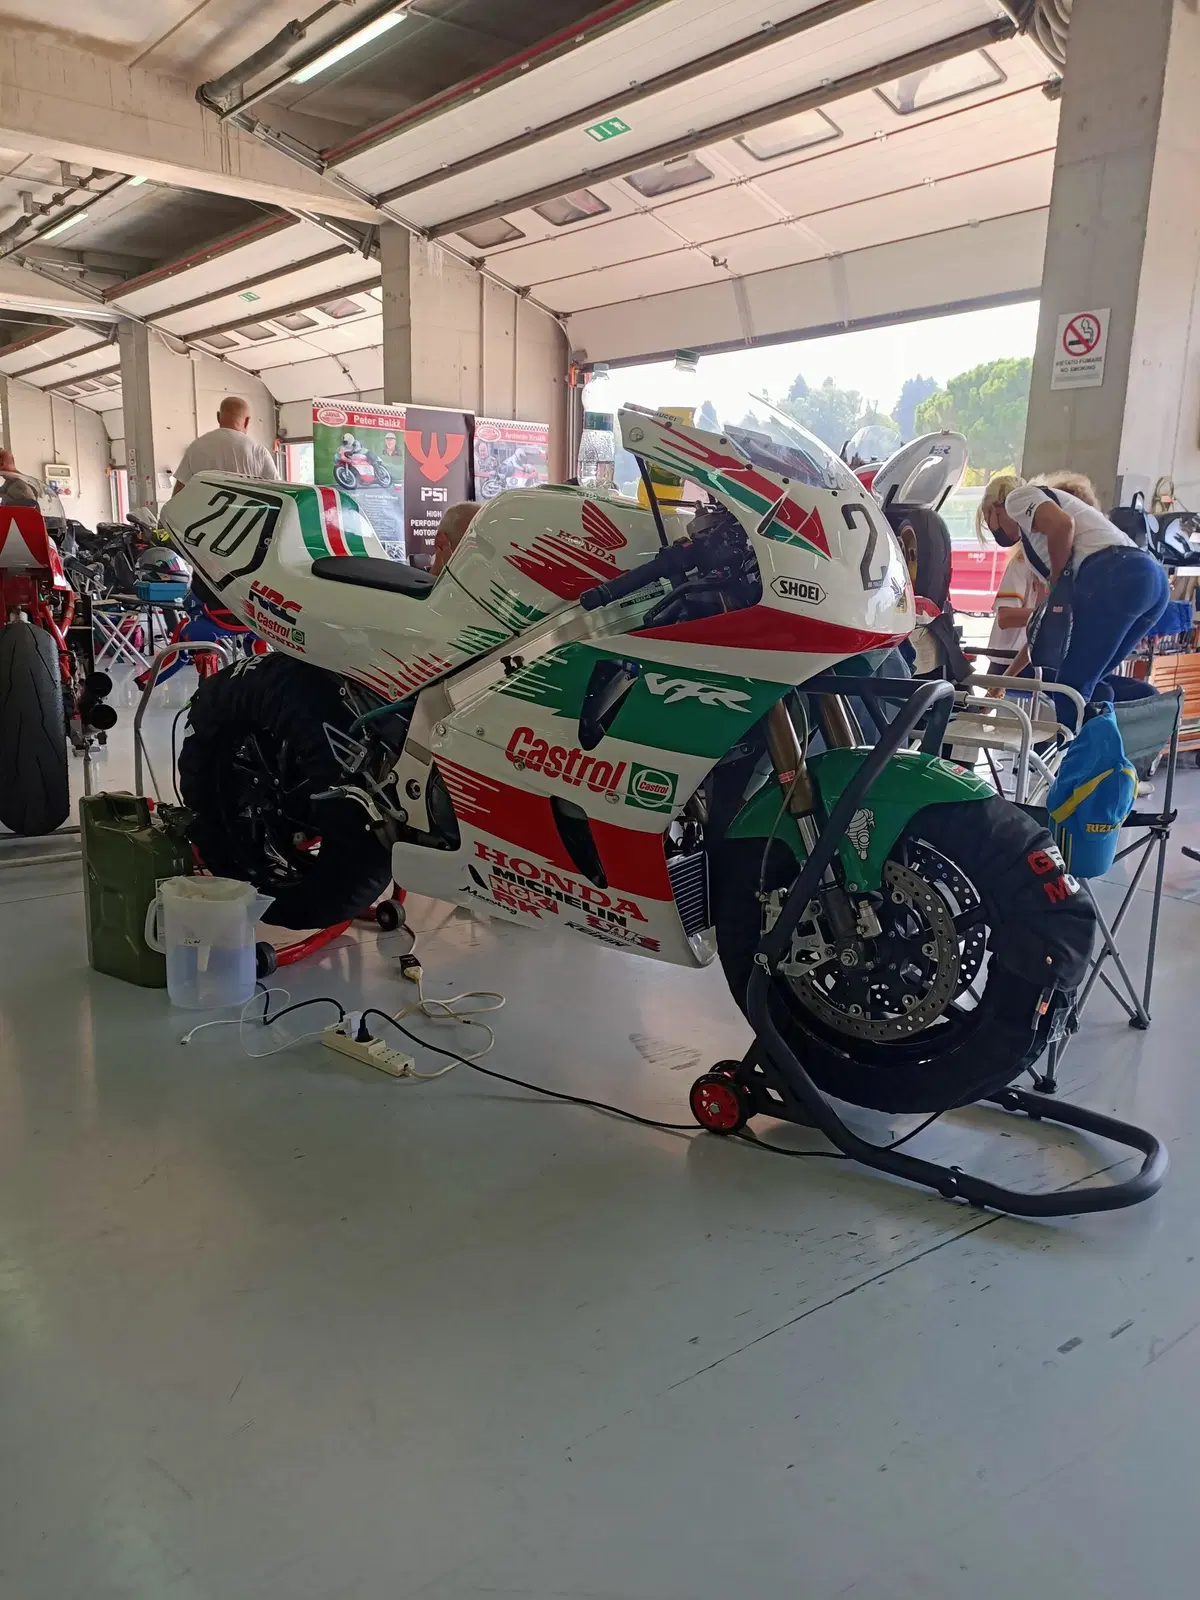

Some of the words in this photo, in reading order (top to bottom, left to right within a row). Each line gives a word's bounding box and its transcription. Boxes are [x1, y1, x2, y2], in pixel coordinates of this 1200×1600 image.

[1070, 364, 1096, 372] SMOKING
[353, 414, 376, 425] Peter
[184, 490, 268, 557] 20
[426, 510, 442, 518] HIGH
[557, 529, 617, 565] HONDA
[249, 580, 303, 625] HRC
[779, 580, 819, 601] SHOEI
[256, 611, 290, 637] Castrol
[257, 625, 307, 654] HONDA
[504, 726, 627, 797] Castrol
[639, 780, 669, 794] Castrol
[474, 841, 649, 923] HONDA
[489, 876, 549, 910] NGK
[491, 865, 627, 927] MICHELIN
[491, 890, 545, 920] RK
